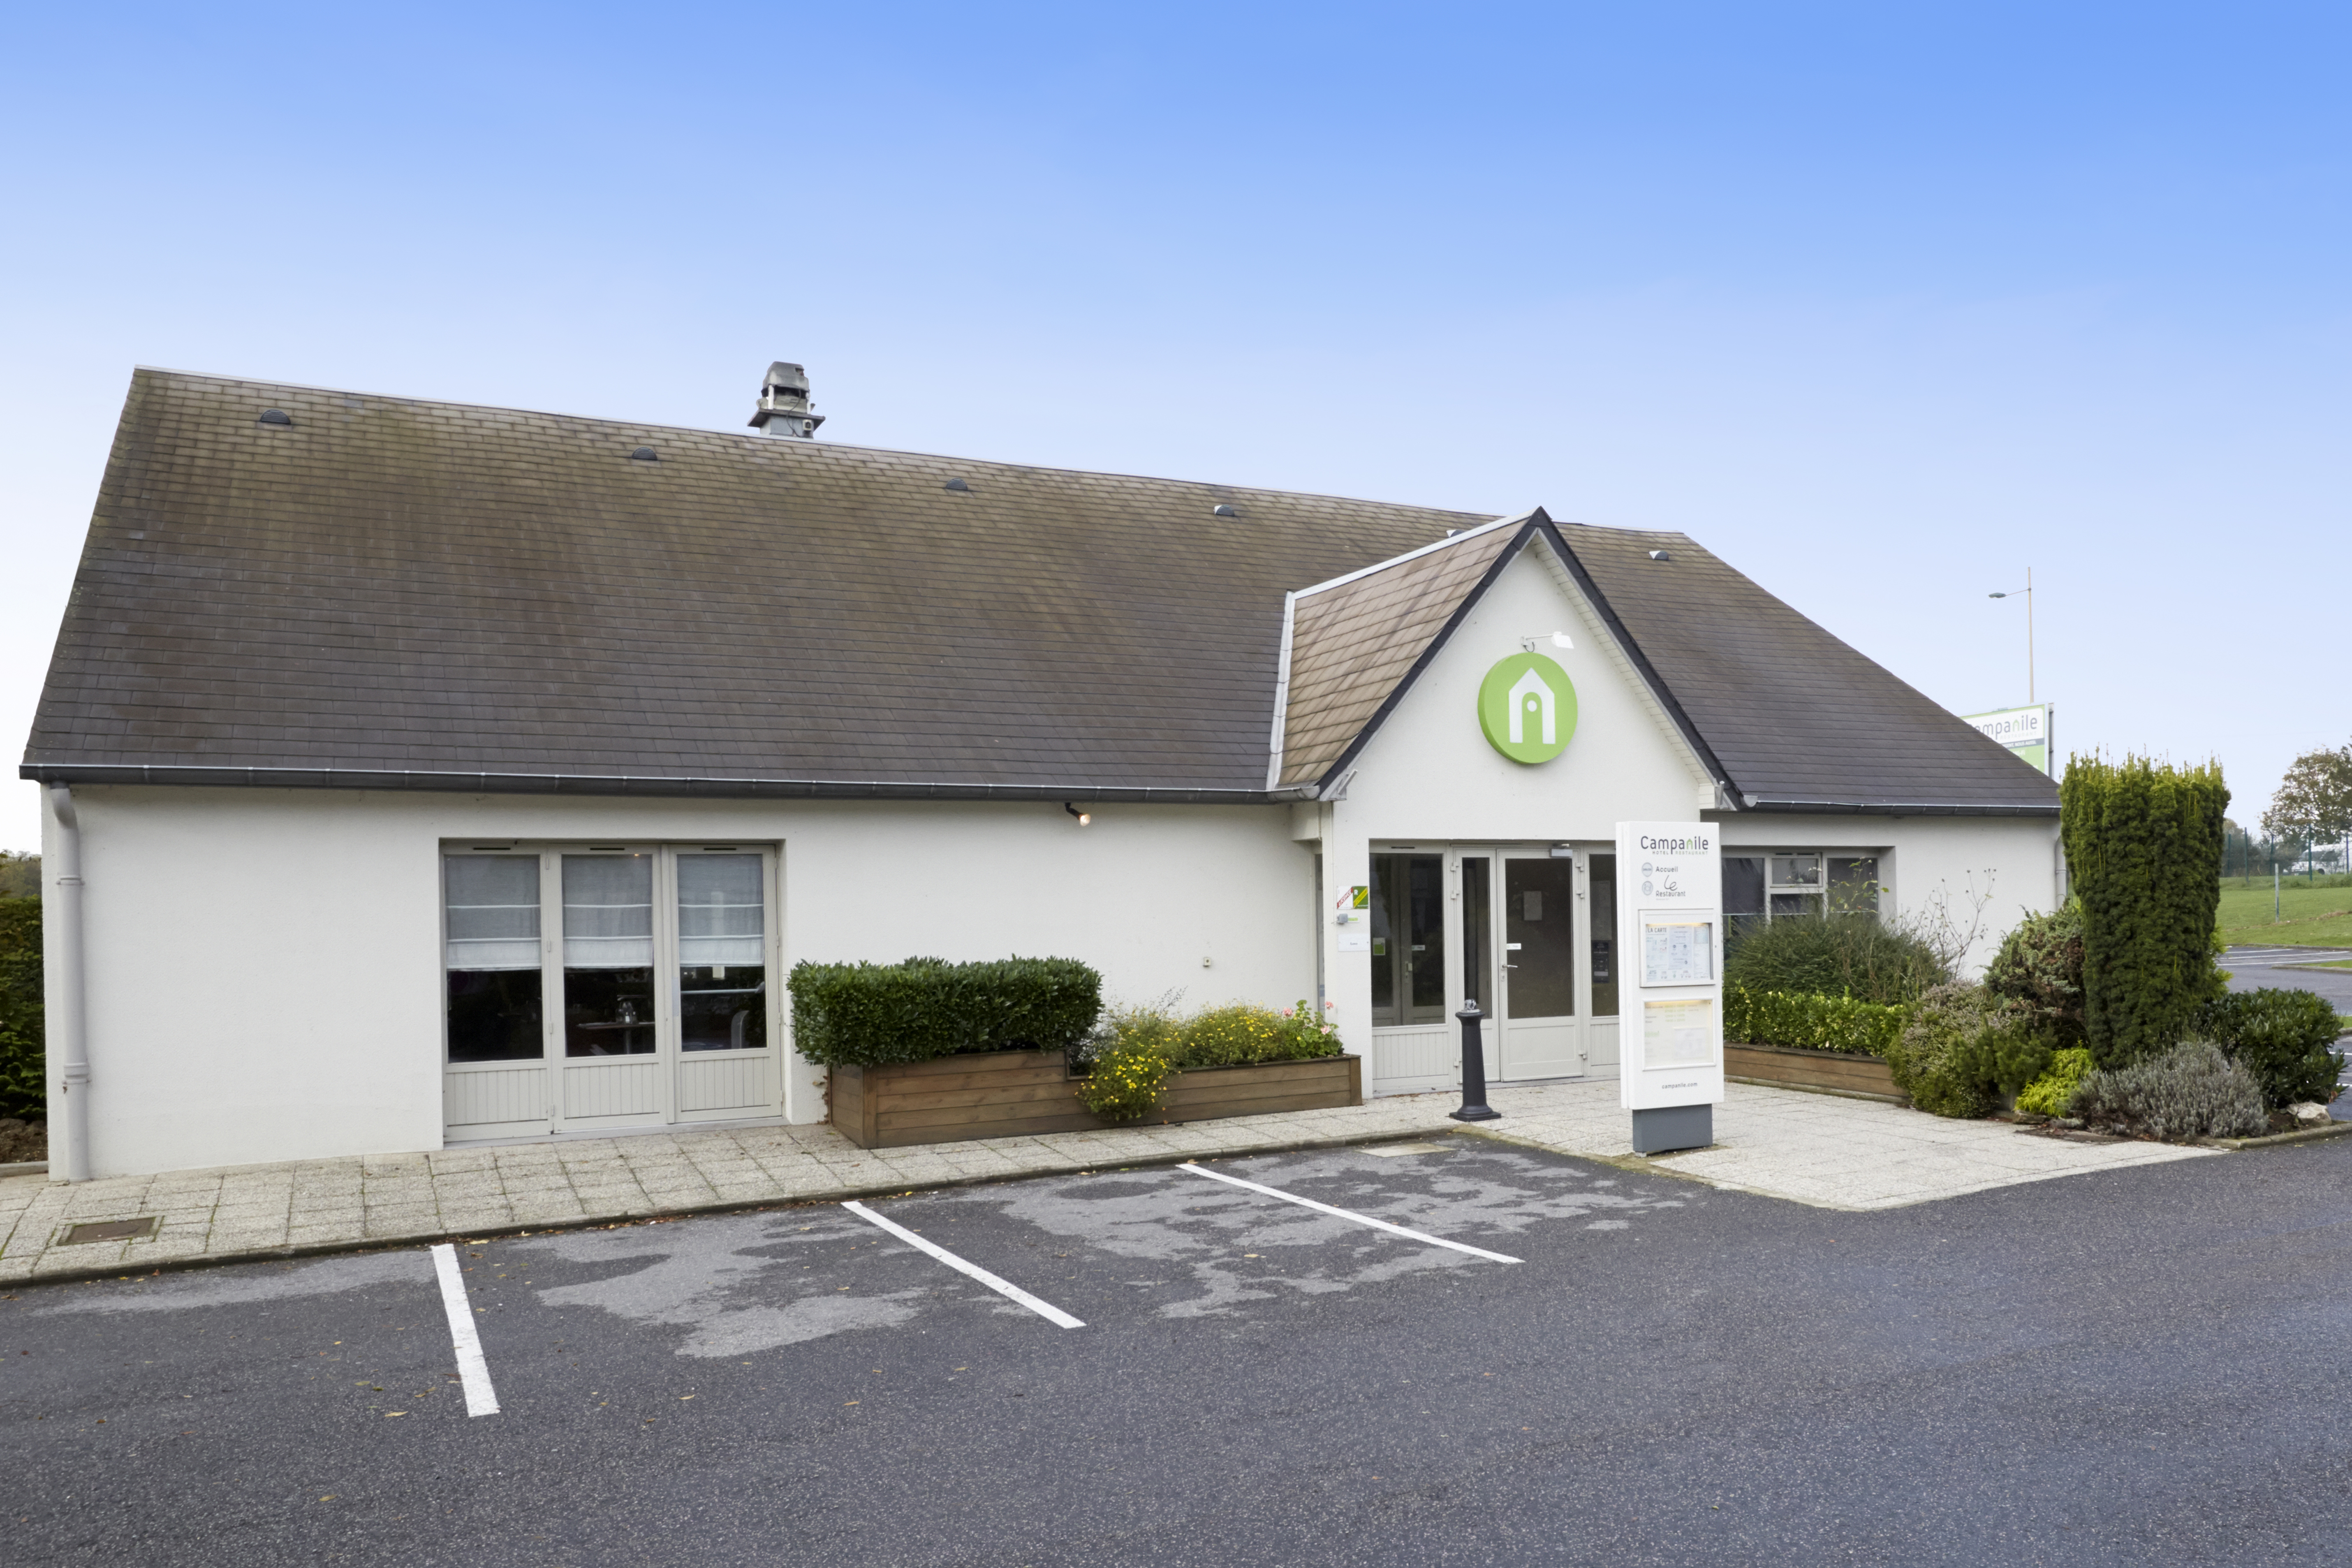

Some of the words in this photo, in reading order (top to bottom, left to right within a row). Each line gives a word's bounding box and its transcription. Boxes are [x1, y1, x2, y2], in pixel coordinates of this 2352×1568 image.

[1968, 715, 2037, 740] mpanile
[1641, 836, 1708, 855] Campanile
[1338, 889, 1352, 906] LICENCE
